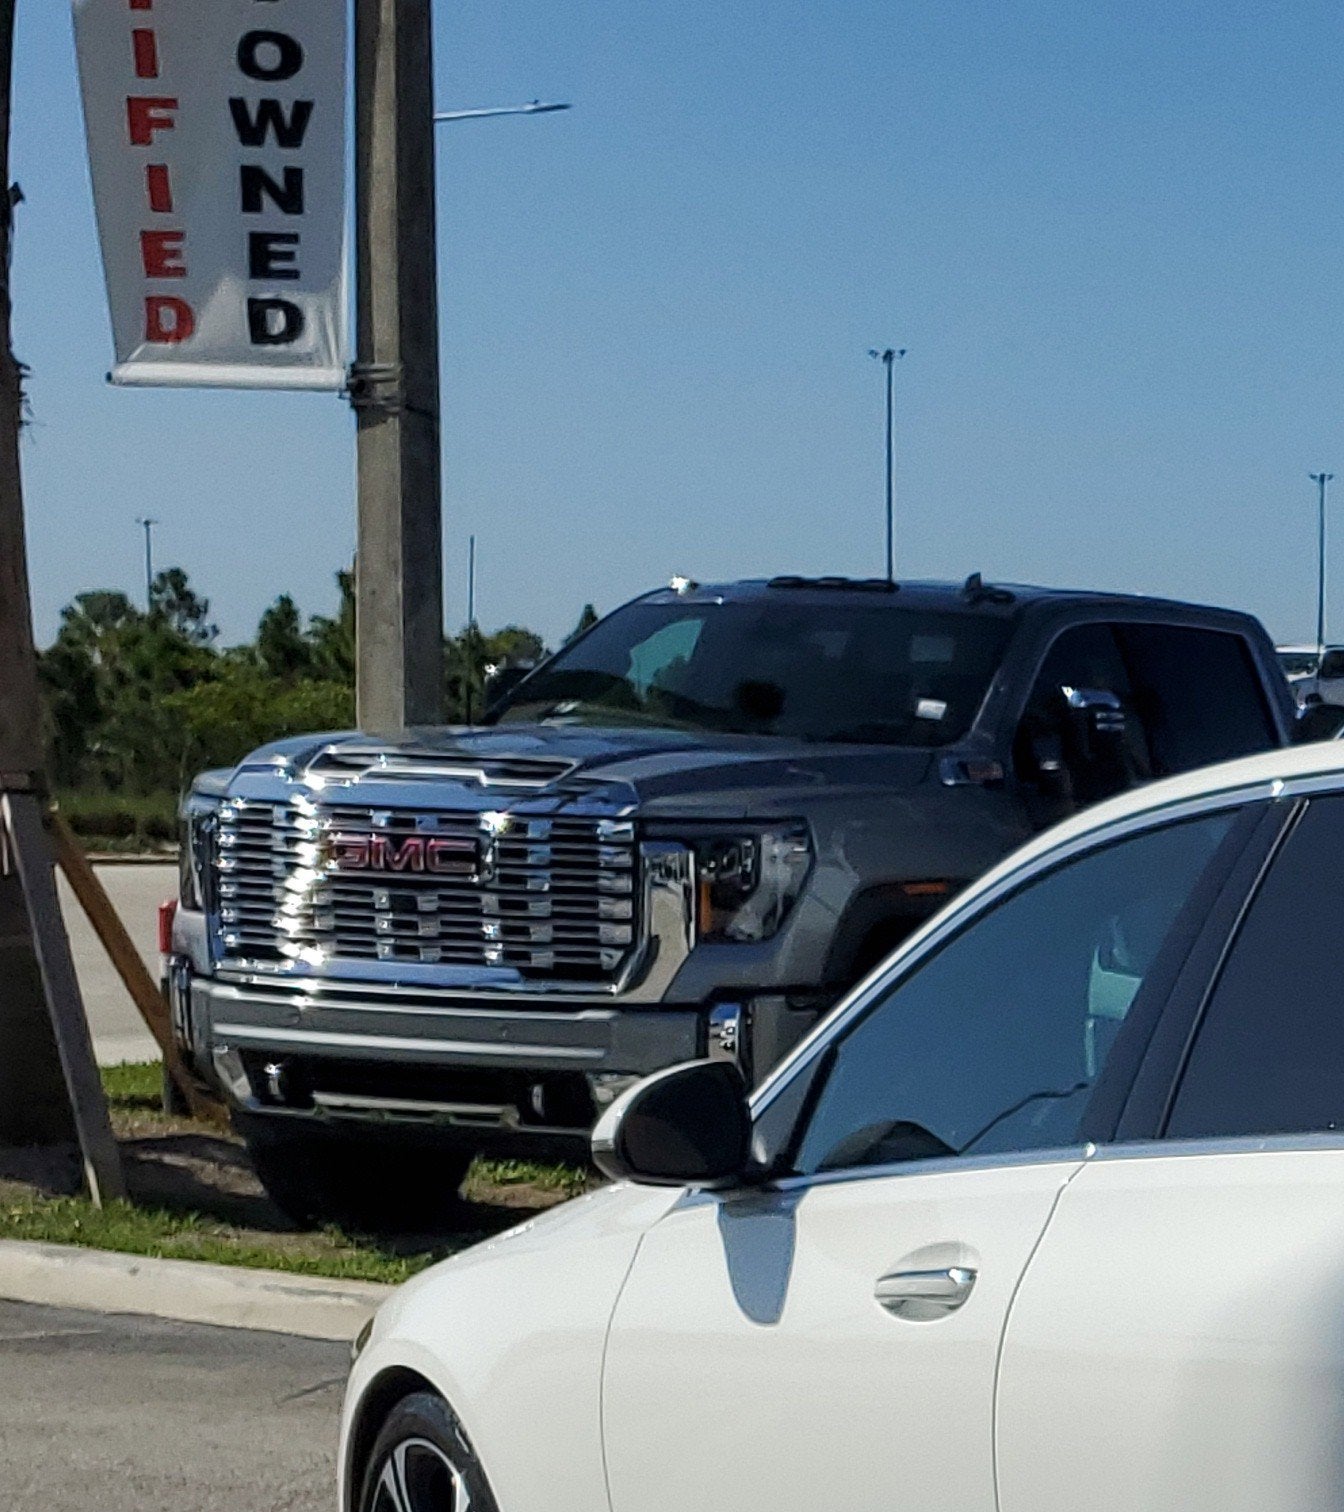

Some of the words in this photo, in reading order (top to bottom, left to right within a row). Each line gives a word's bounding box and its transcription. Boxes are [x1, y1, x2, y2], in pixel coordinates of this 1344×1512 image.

[127, 0, 196, 344] IFIED
[229, 0, 314, 345] OWNED
[328, 832, 477, 873] GMC
